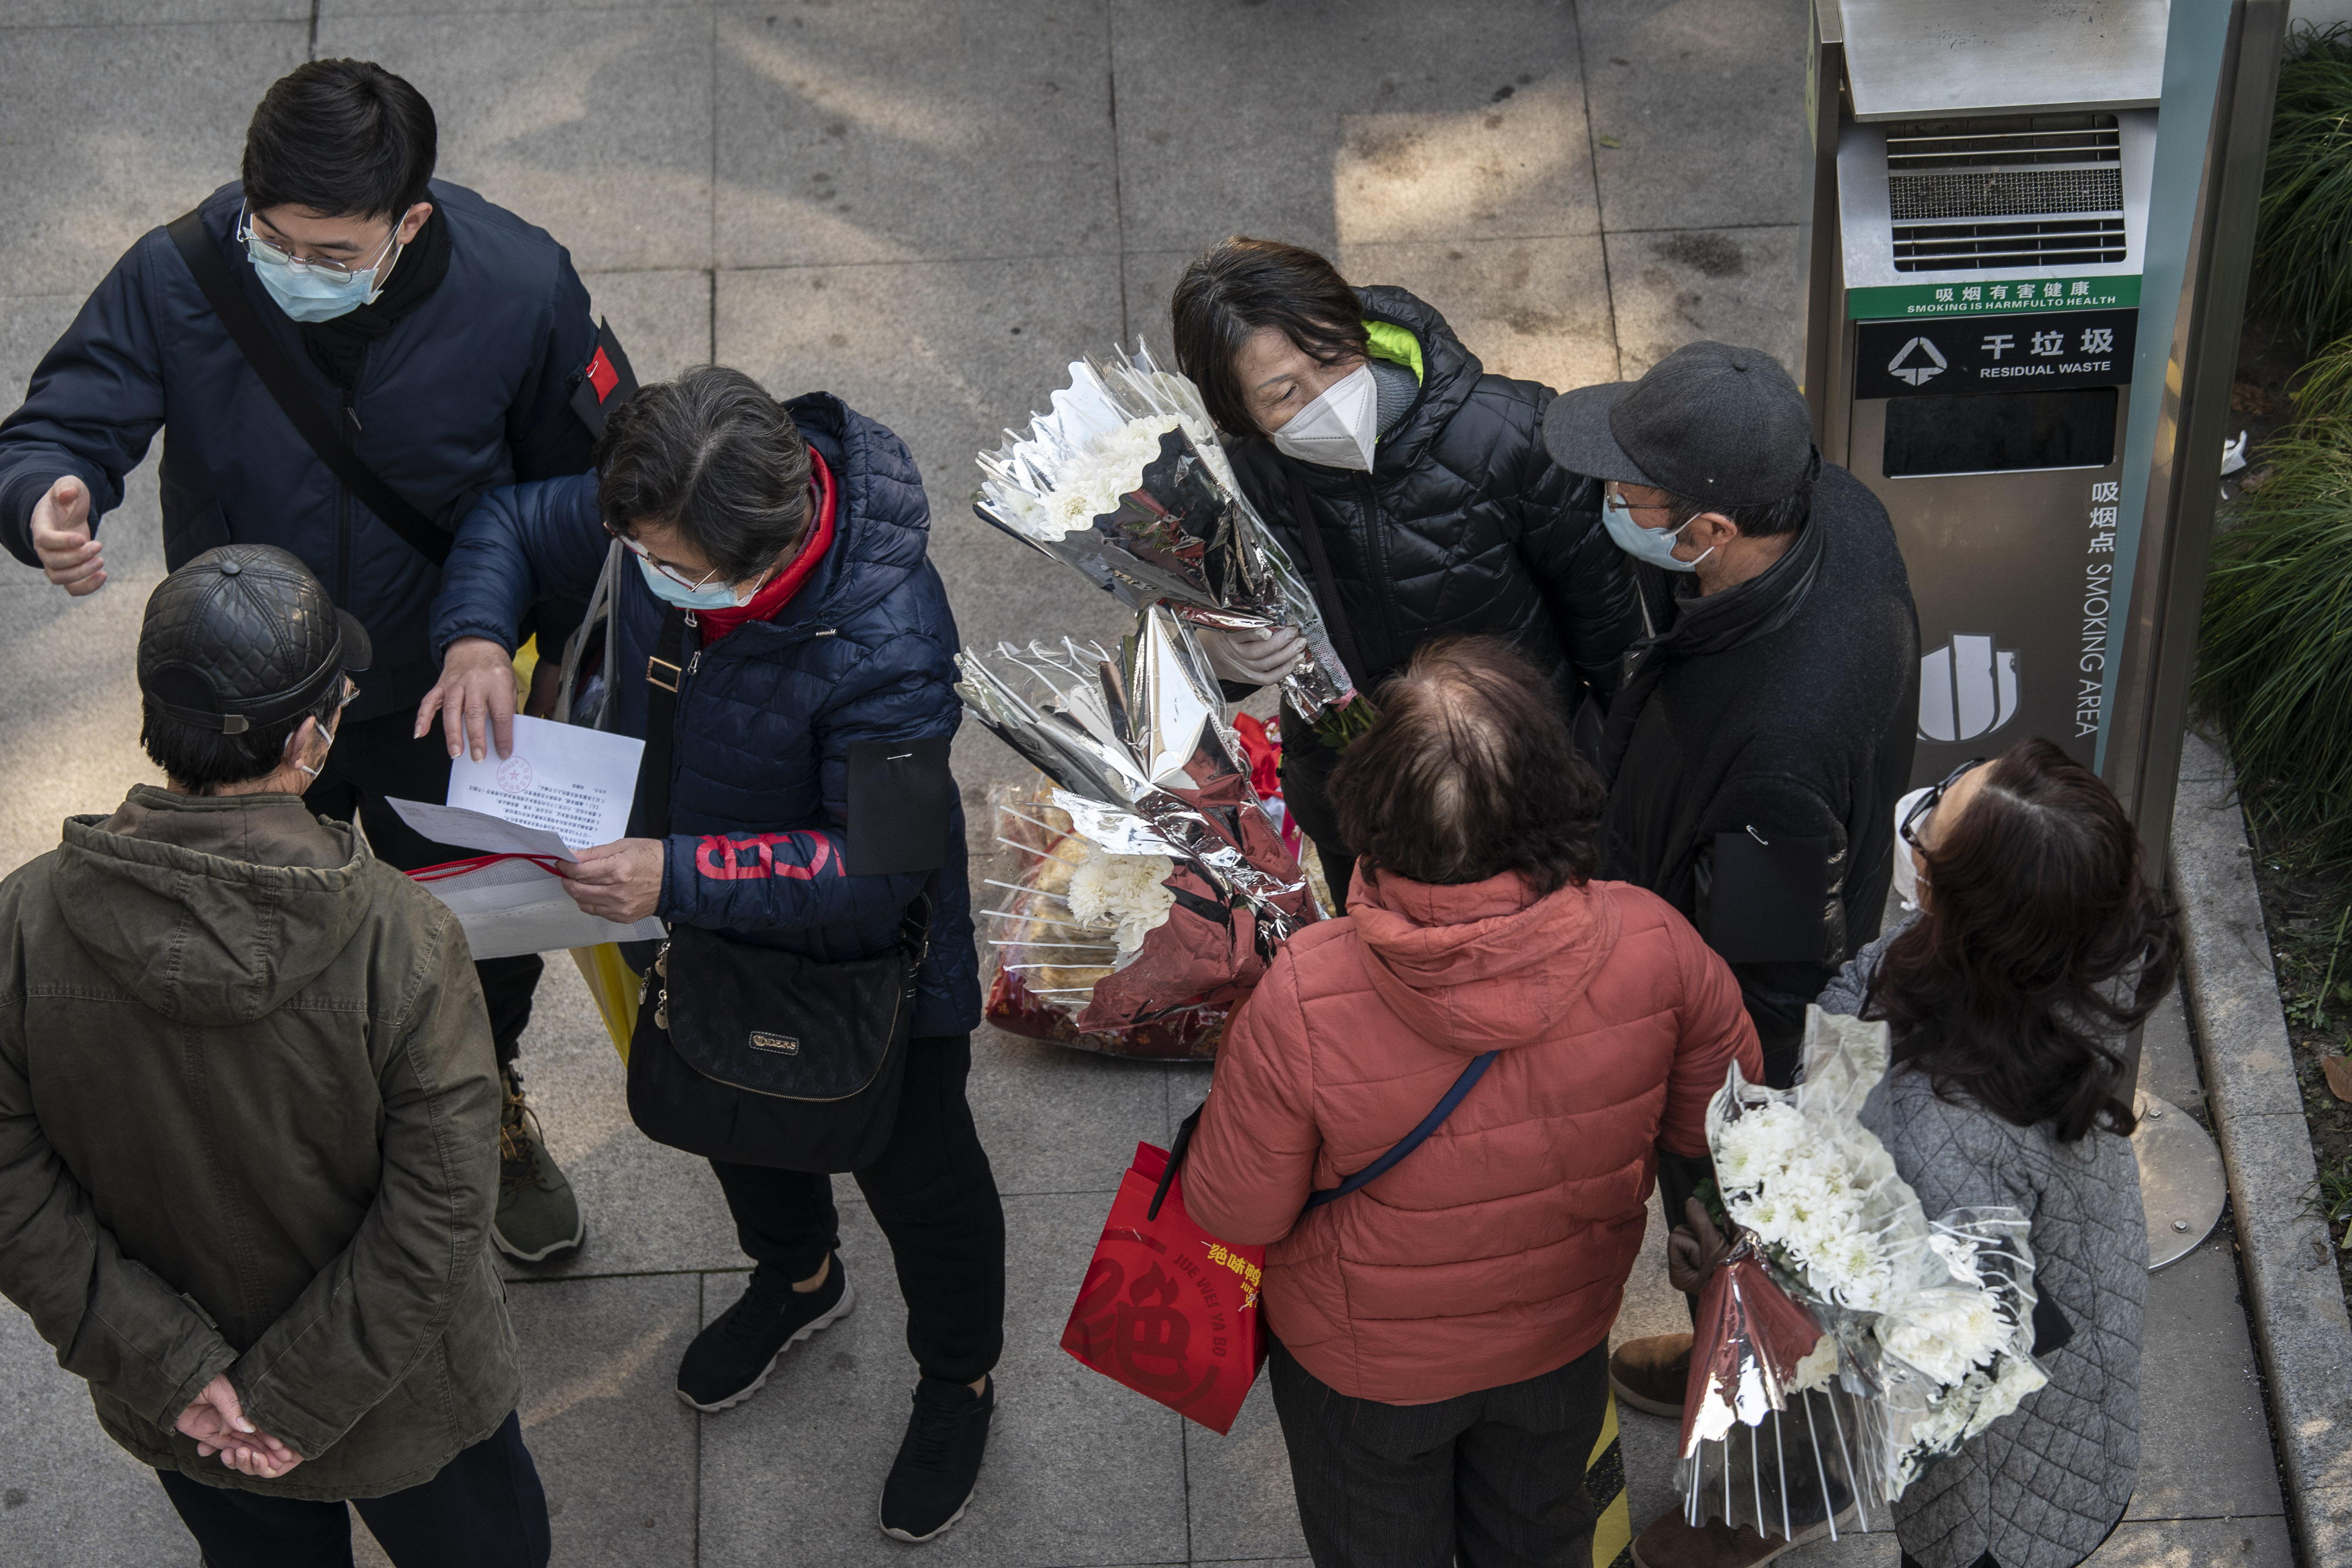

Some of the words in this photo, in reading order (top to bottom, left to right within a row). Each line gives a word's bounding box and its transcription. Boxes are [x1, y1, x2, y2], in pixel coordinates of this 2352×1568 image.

[1935, 280, 2090, 302] 吸烟有害健康
[1907, 303, 1968, 313] SMOKING
[2066, 296, 2116, 306] HEALTH
[1981, 328, 2114, 360] 干垃圾
[1980, 365, 2055, 378] RESIDUAL
[2059, 361, 2112, 374] WASTE
[2087, 482, 2119, 554] 吸烟点
[2079, 564, 2112, 672] SMOKING
[2075, 679, 2102, 738] AREA
[1172, 1253, 1201, 1279] JUE
[1196, 1277, 1220, 1308] WEI
[1211, 1312, 1226, 1332] YA
[1212, 1336, 1227, 1358] BO
